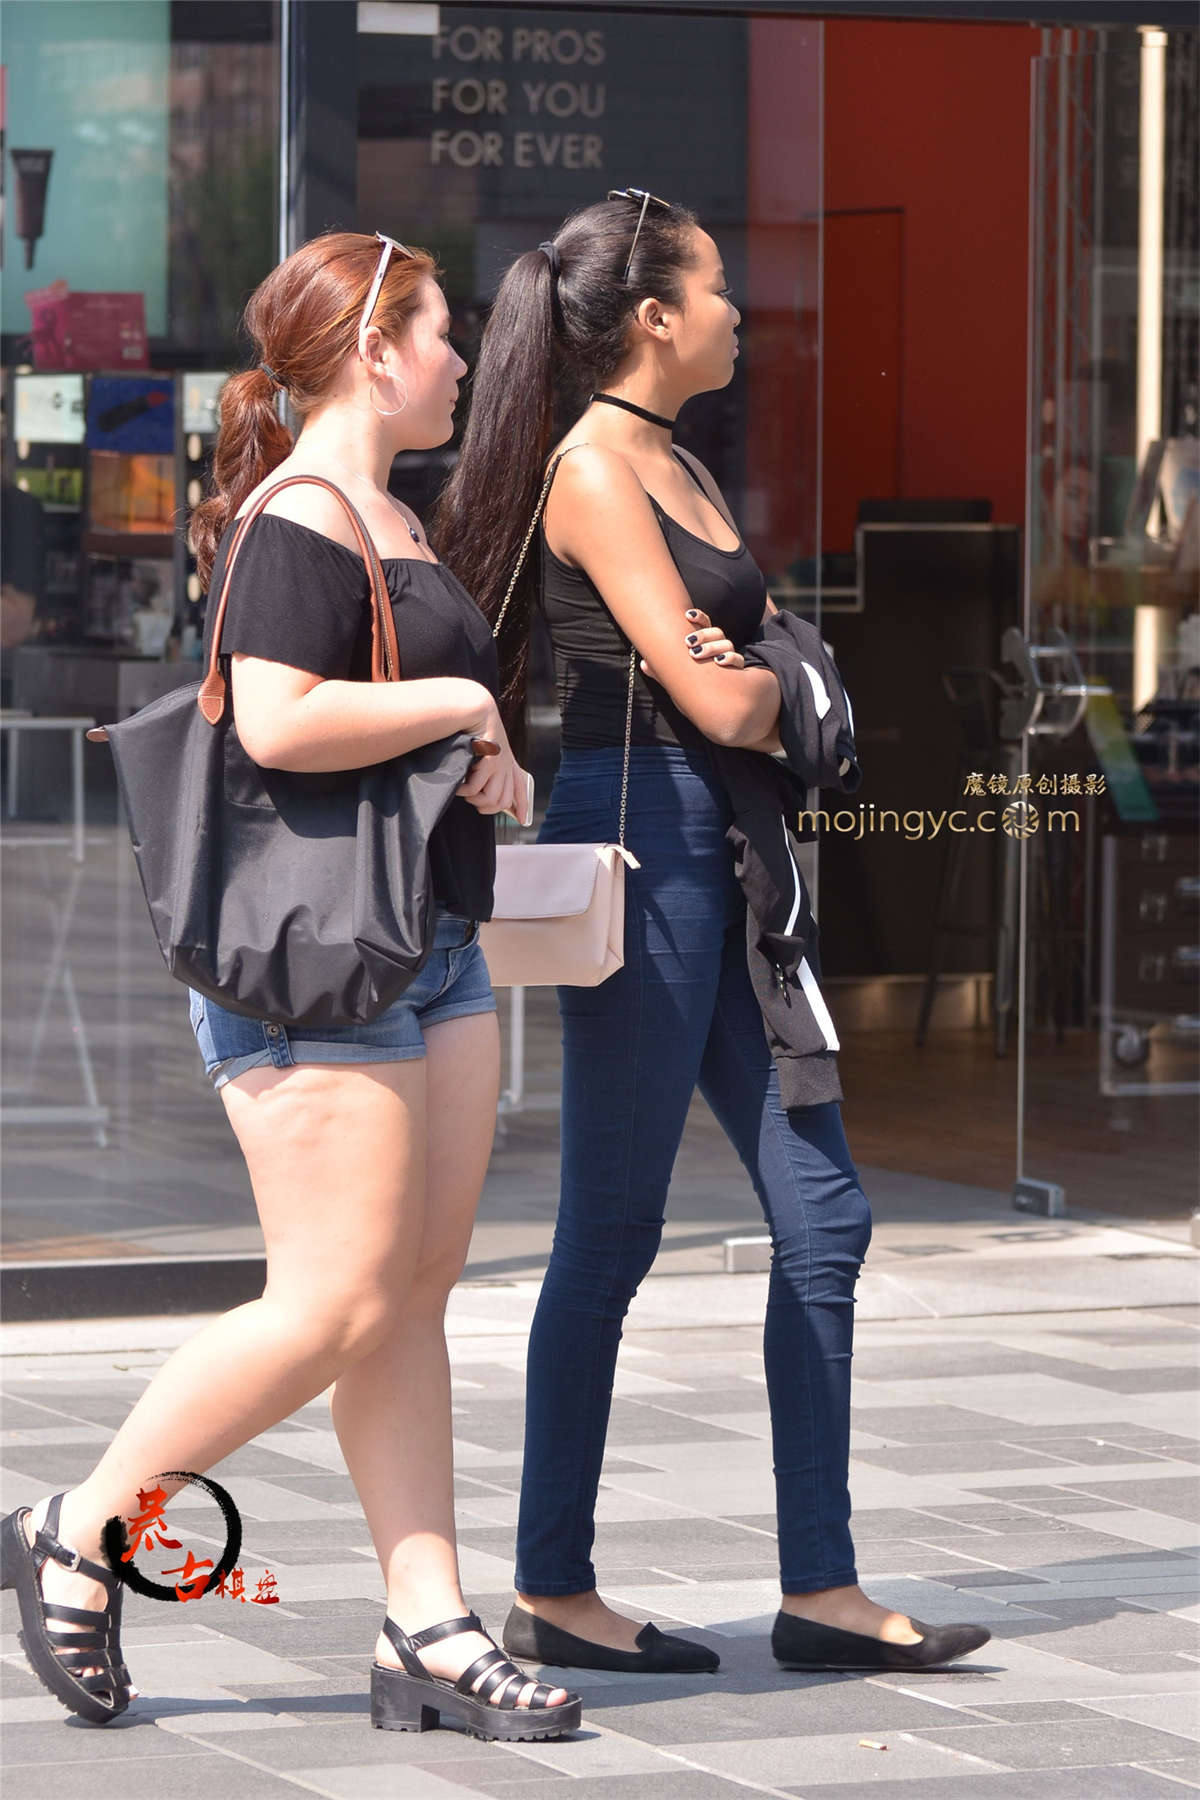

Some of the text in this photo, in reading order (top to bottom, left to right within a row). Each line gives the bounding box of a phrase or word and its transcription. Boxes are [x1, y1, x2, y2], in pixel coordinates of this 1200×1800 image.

[431, 25, 606, 66] FOR PROS
[431, 77, 606, 118] FOR YOU
[430, 130, 602, 169] FOR EVER
